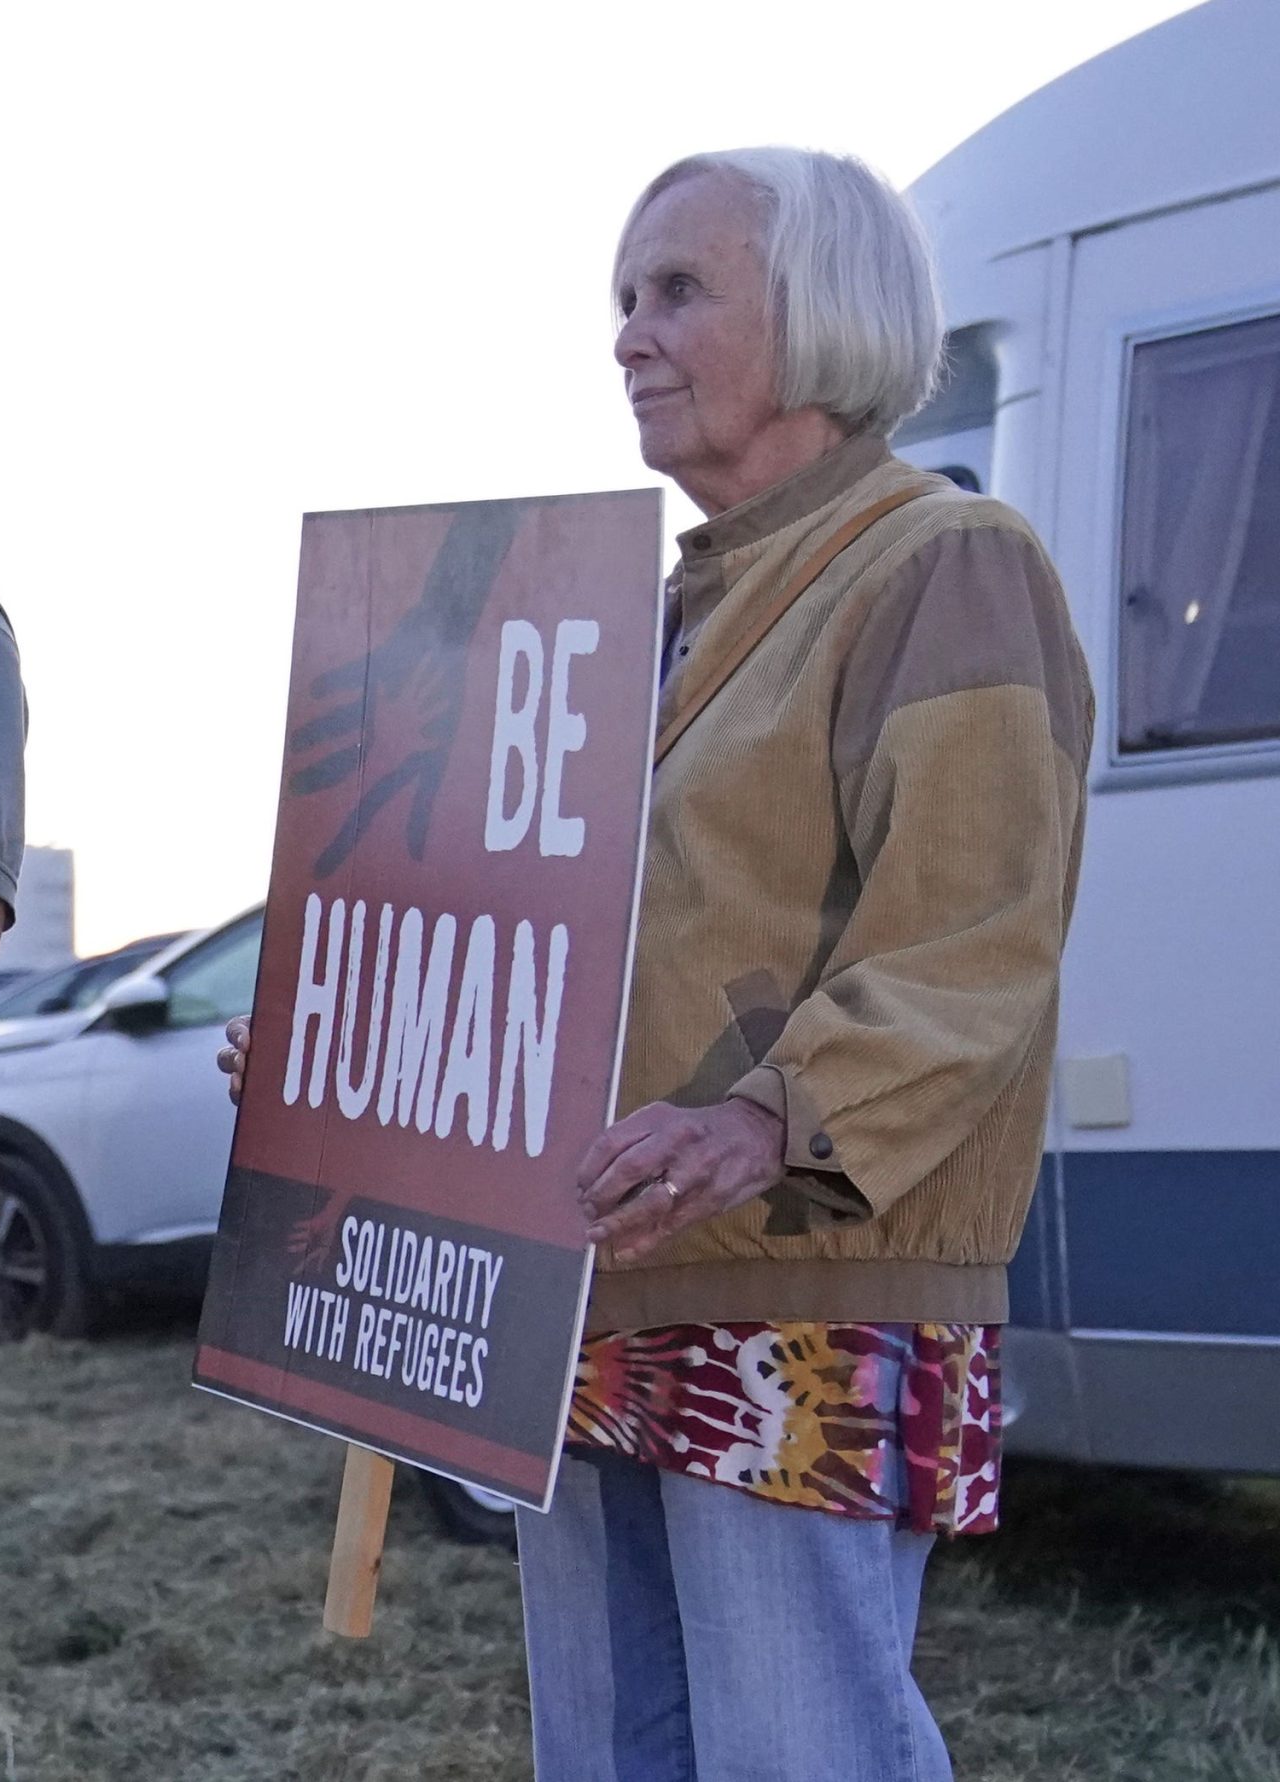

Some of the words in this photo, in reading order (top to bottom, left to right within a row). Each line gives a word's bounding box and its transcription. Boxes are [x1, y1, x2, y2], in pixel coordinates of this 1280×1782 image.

[485, 619, 600, 857] BE
[284, 893, 569, 1157] HUMAN
[285, 1282, 349, 1362] WITH
[354, 1304, 488, 1407] REFUGEES
[336, 1216, 503, 1328] SOLIDARITY
